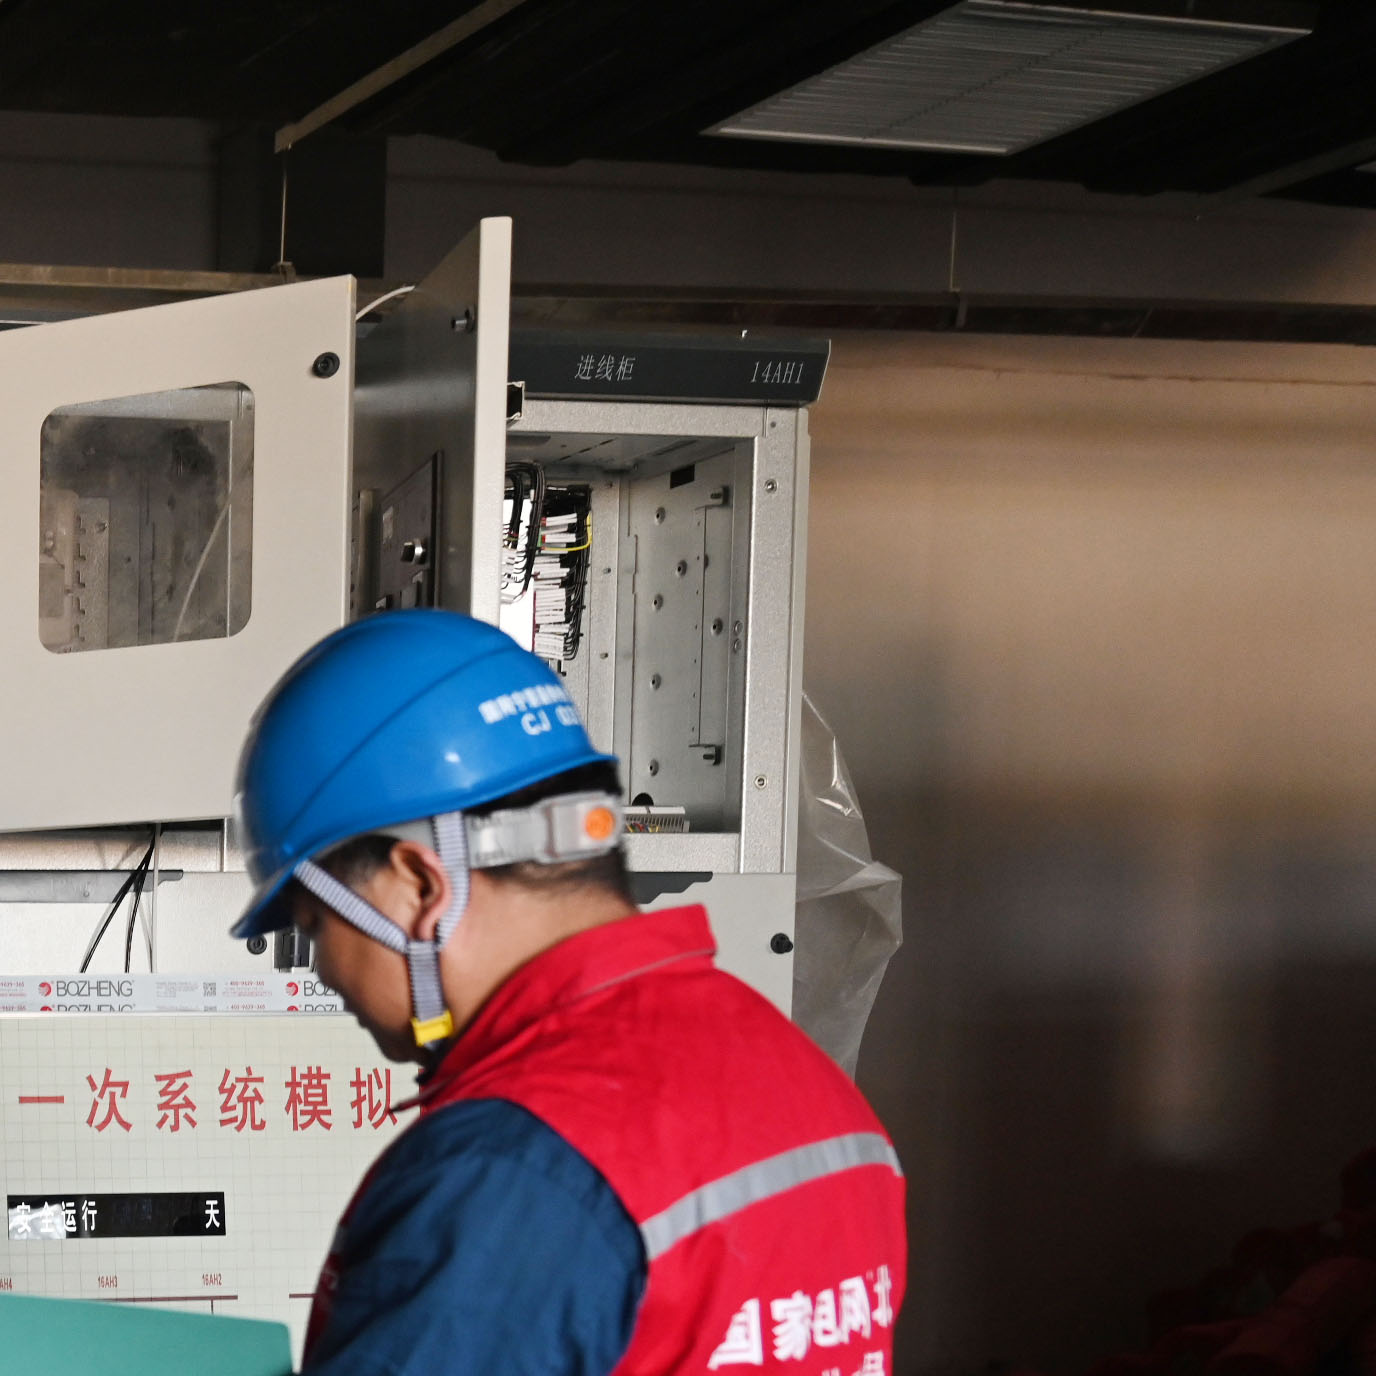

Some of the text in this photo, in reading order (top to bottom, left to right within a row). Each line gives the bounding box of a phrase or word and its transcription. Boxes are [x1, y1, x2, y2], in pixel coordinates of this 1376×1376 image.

[575, 355, 804, 384] 进线柜 14AH1
[57, 980, 133, 997] BOZHENG
[16, 1200, 220, 1233] 安全运行 天
